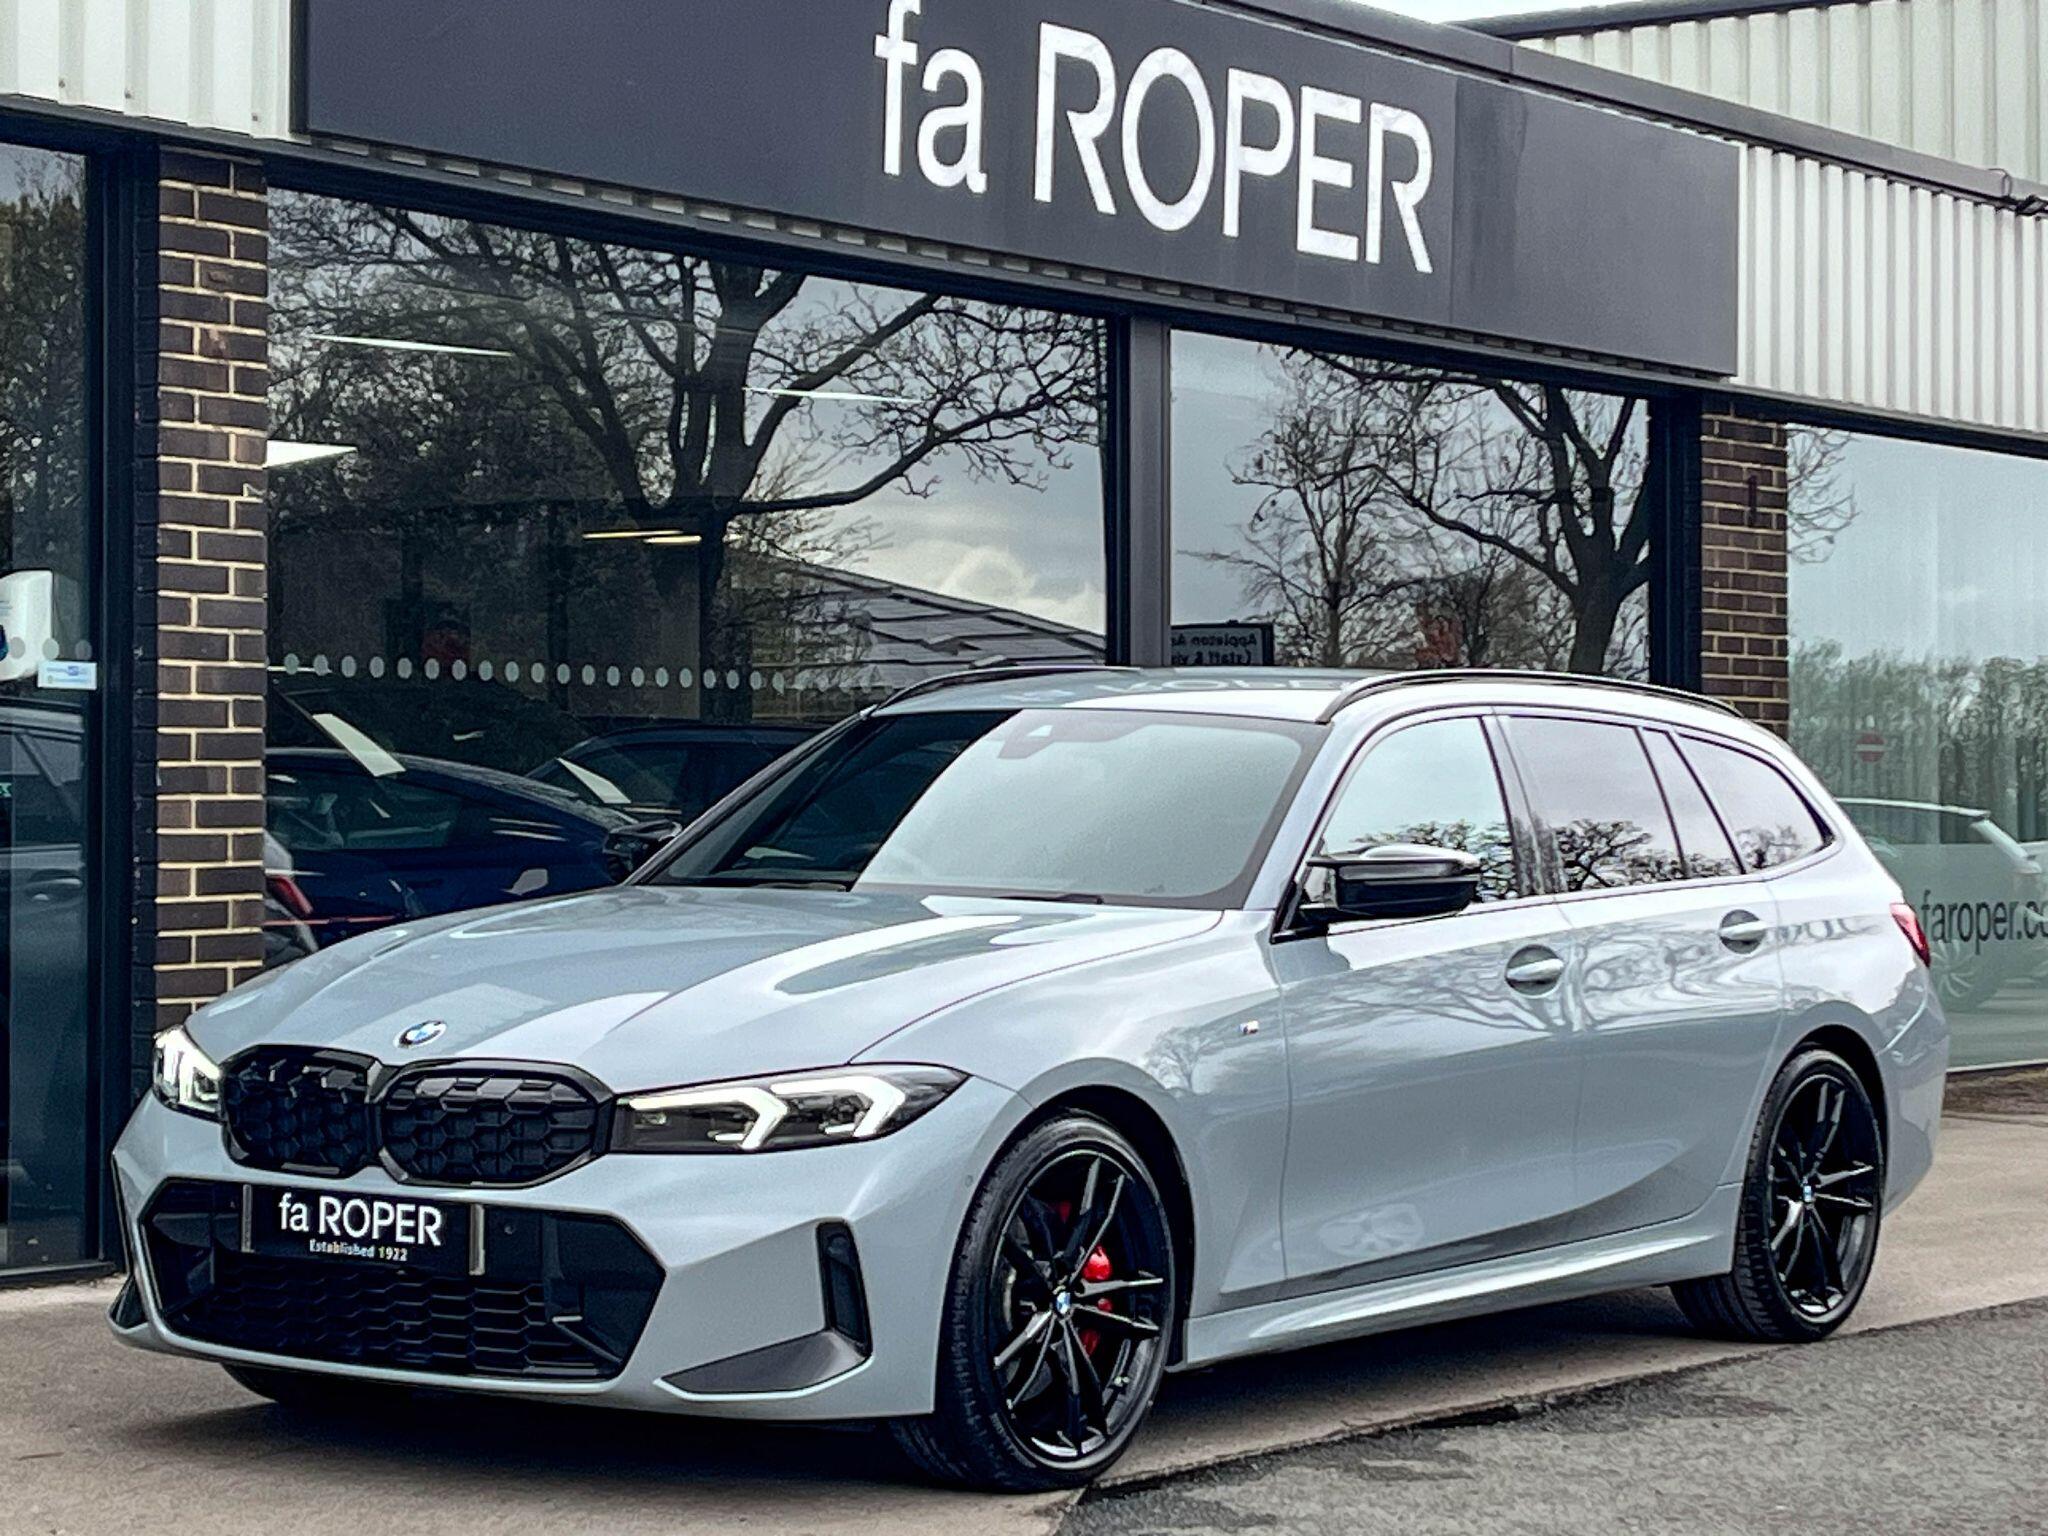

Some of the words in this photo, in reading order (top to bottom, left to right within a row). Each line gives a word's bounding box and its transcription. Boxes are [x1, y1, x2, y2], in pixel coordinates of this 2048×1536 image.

[874, 0, 987, 194] fa
[1034, 21, 1433, 274] ROPER
[278, 1192, 309, 1232] fa
[318, 1195, 442, 1246] ROPER
[309, 1238, 375, 1259] Established
[378, 1246, 408, 1262] 1922
